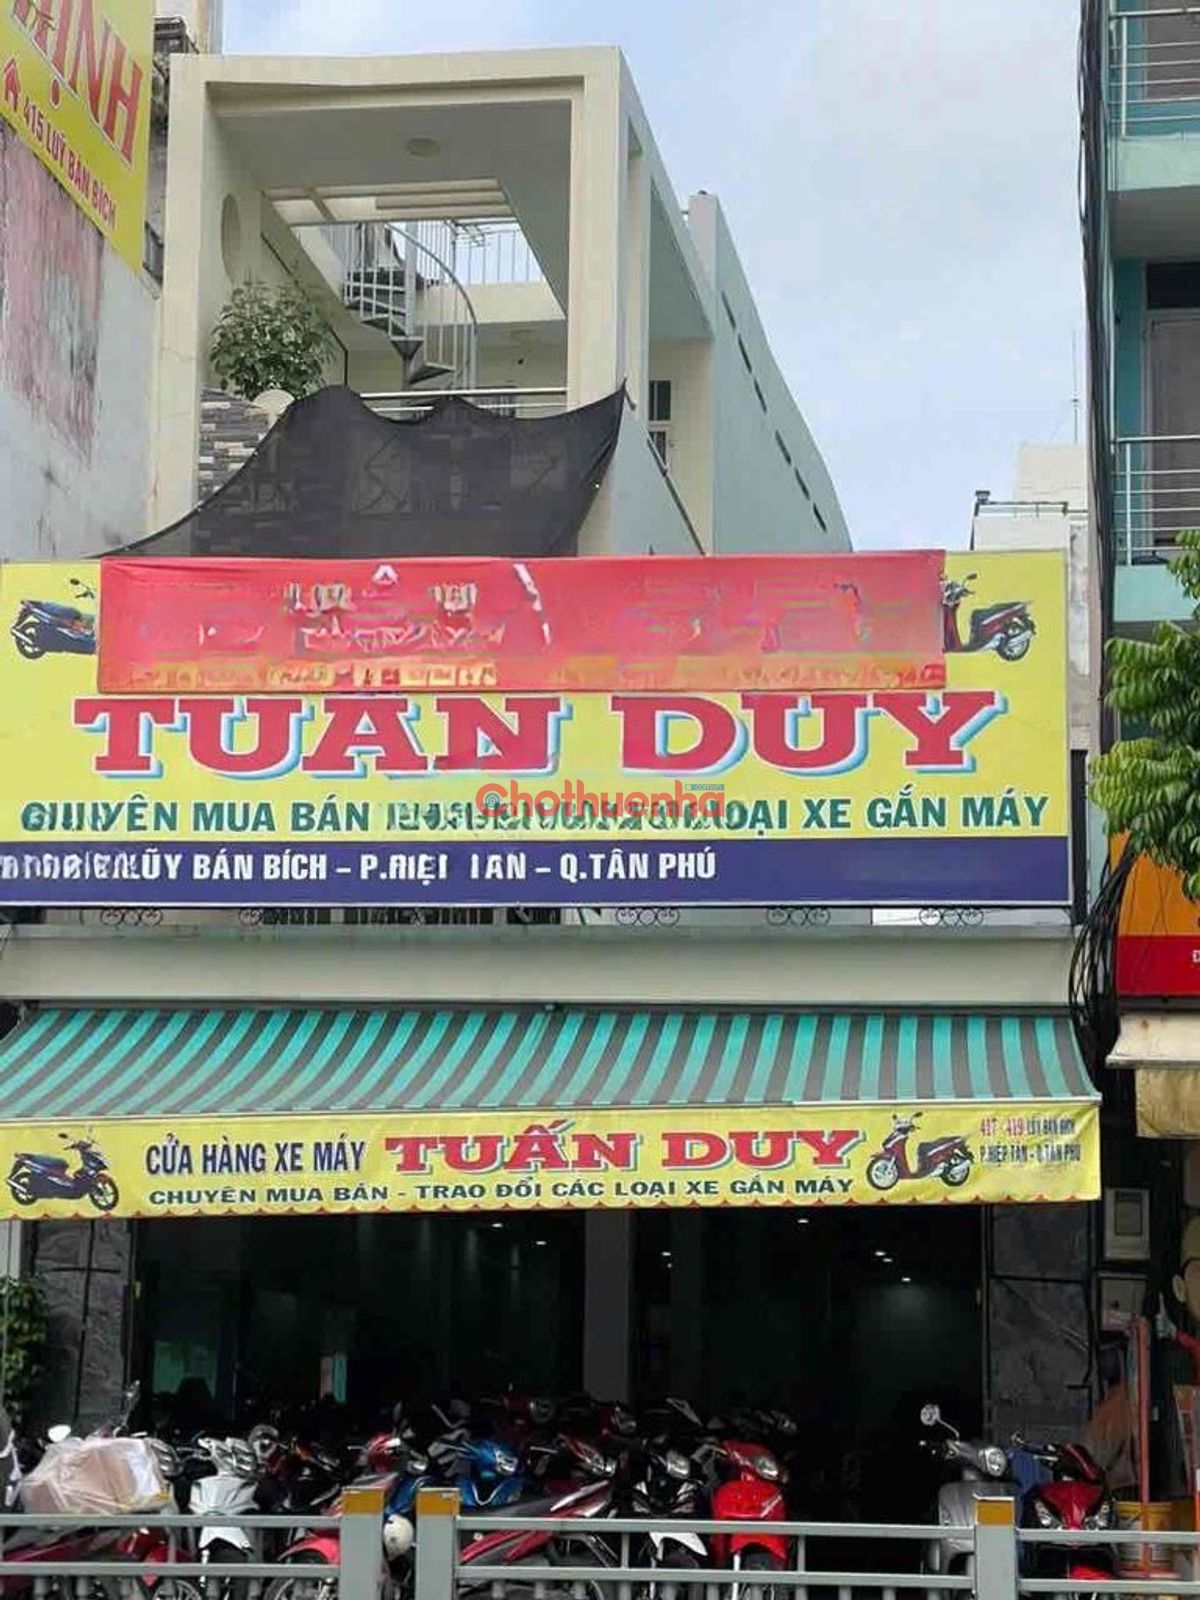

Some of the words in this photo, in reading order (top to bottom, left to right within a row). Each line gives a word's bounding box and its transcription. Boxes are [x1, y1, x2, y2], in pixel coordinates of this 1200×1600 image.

[24, 97, 44, 141] 415
[611, 690, 1008, 777] DUY
[193, 802, 276, 831] MUA
[291, 794, 370, 831] BÁN
[802, 799, 851, 828] XE
[866, 784, 946, 829] GẮN
[962, 788, 1049, 827] MÁY
[193, 849, 254, 880] BÁN
[263, 849, 328, 880] BÍCH
[560, 848, 649, 884] Q.TÂN
[659, 847, 716, 880] PHÚ
[146, 1133, 194, 1175] CỬA
[202, 1135, 266, 1174] HÀNG
[275, 1142, 304, 1172] XE
[313, 1132, 365, 1171] MÁY
[385, 1118, 643, 1175] TUẤN
[661, 1129, 867, 1172] DUY
[150, 1185, 256, 1204] CHUYÊN
[266, 1187, 324, 1202] MUA
[334, 1182, 388, 1201] BÁN
[416, 1184, 487, 1199] TRAO
[496, 1176, 542, 1198] ĐỔI
[552, 1179, 604, 1197] CÁC
[615, 1181, 675, 1198] LOẠI
[685, 1180, 719, 1195] XE
[730, 1174, 784, 1194] GẮN
[795, 1176, 853, 1193] MÁY
